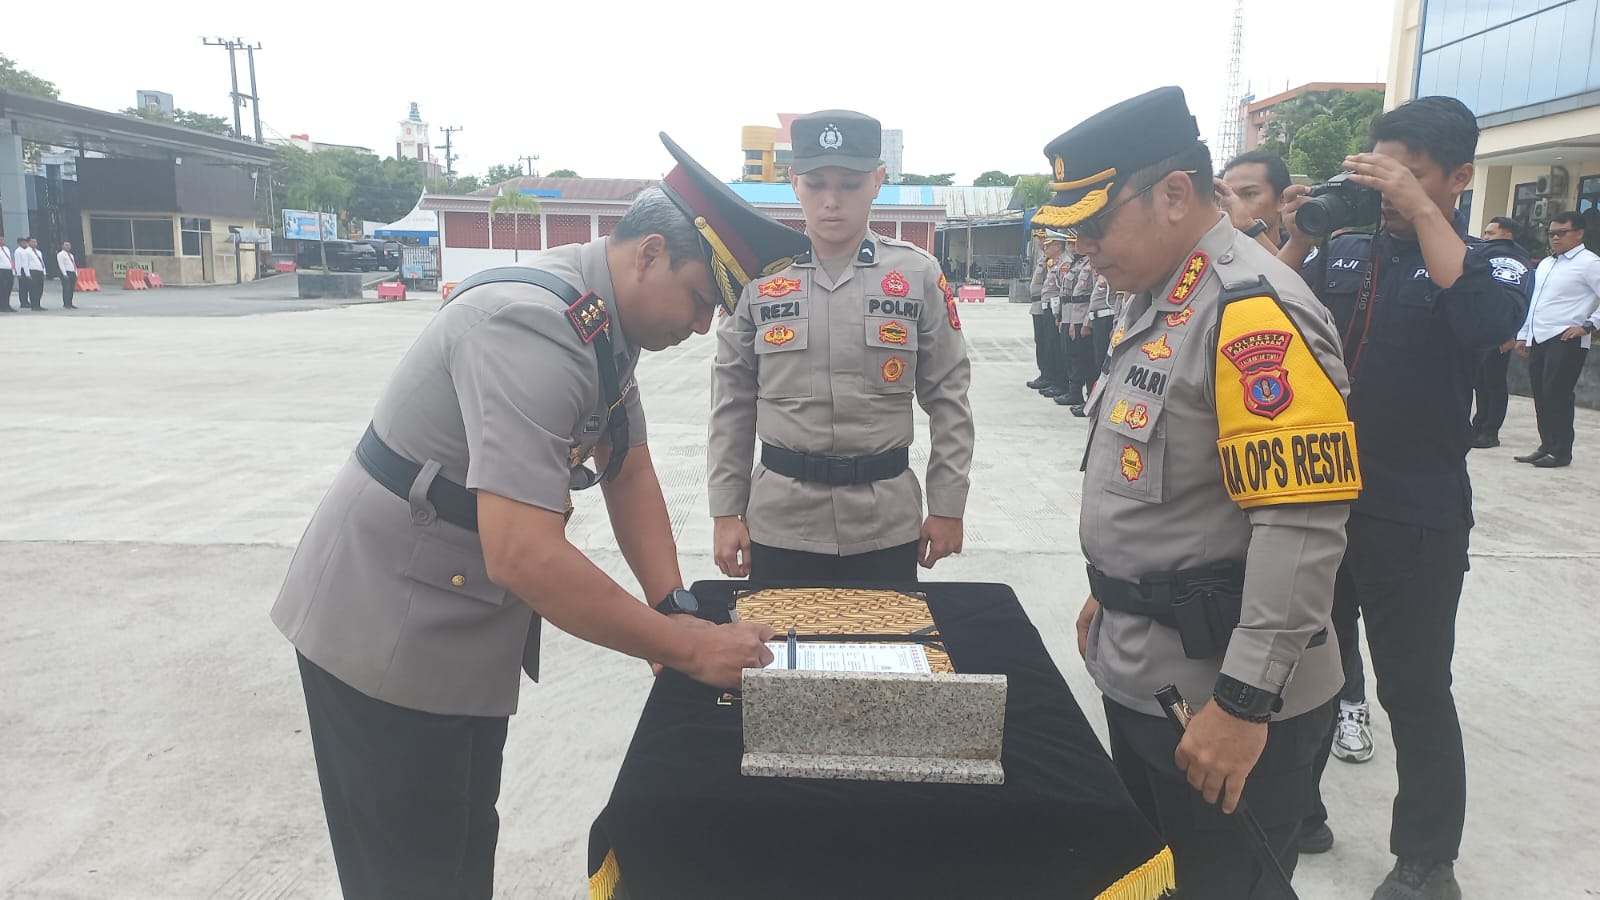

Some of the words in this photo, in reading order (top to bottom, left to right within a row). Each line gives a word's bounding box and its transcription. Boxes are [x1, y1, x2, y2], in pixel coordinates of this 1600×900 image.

[1332, 259, 1360, 270] AJI
[760, 301, 800, 322] REZI
[868, 299, 919, 319] POLRI
[1227, 333, 1285, 353] POLRESTA
[1233, 340, 1282, 355] BALIKPAPAN
[1124, 365, 1167, 396] POLRI
[1221, 444, 1247, 496] KA
[1244, 436, 1289, 492] OPS
[1291, 430, 1357, 487] RESTA
